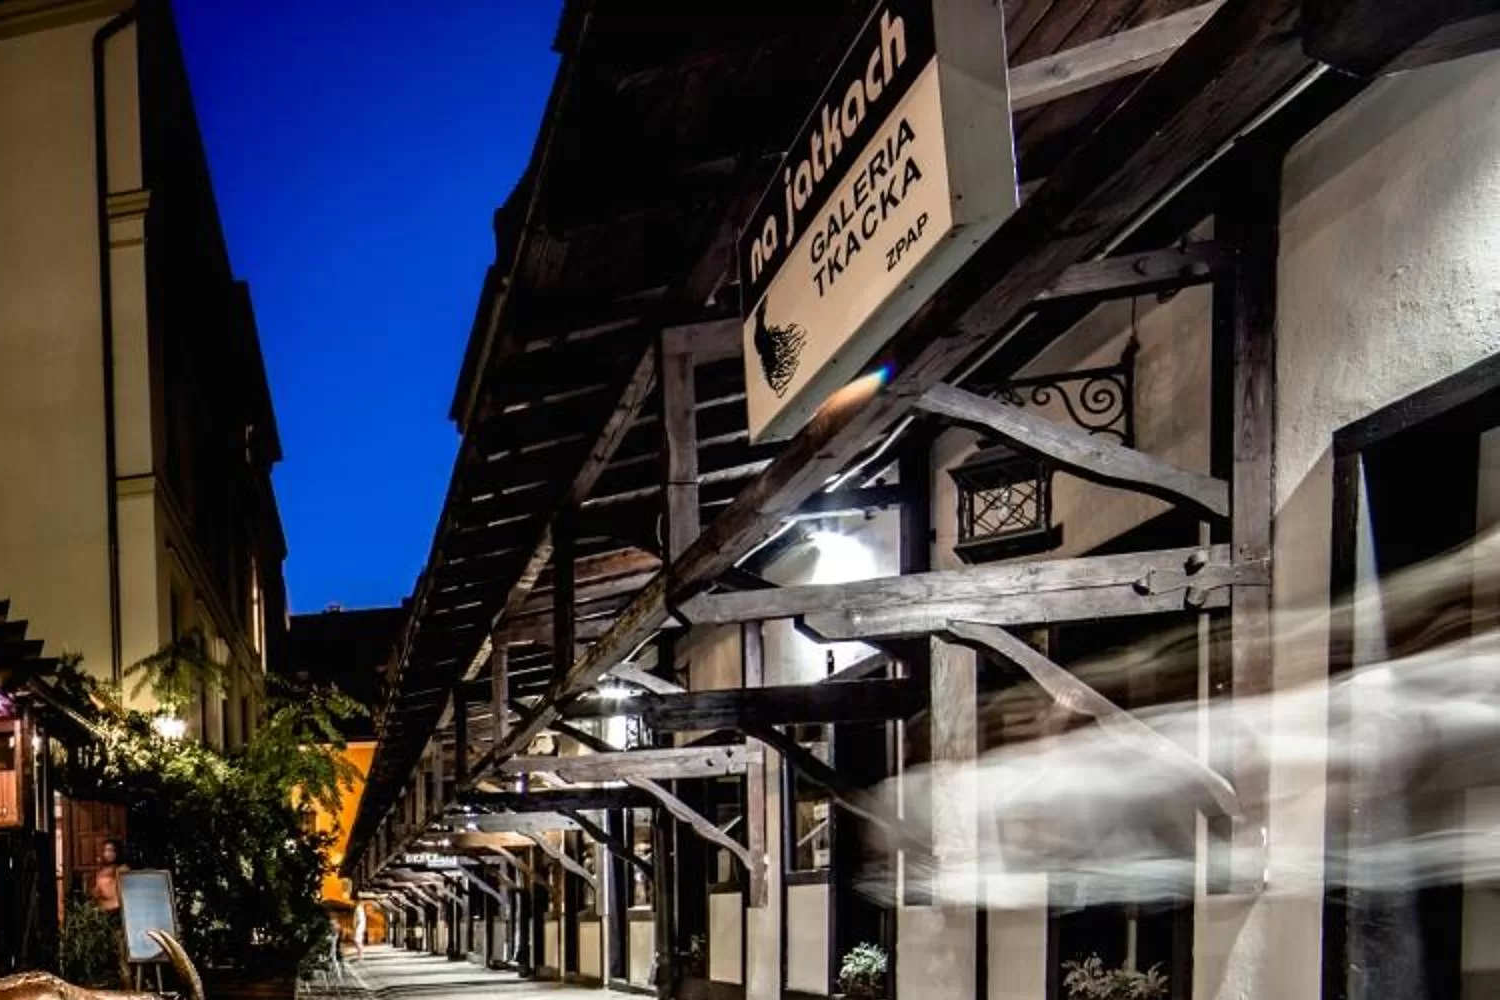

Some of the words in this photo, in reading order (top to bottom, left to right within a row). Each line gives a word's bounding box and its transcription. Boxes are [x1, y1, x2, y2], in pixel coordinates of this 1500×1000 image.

[751, 214, 778, 283] na
[784, 8, 908, 243] jatkach
[810, 118, 916, 265] GALERIA
[813, 159, 923, 298] TKACKA
[885, 212, 930, 272] ZPAP
